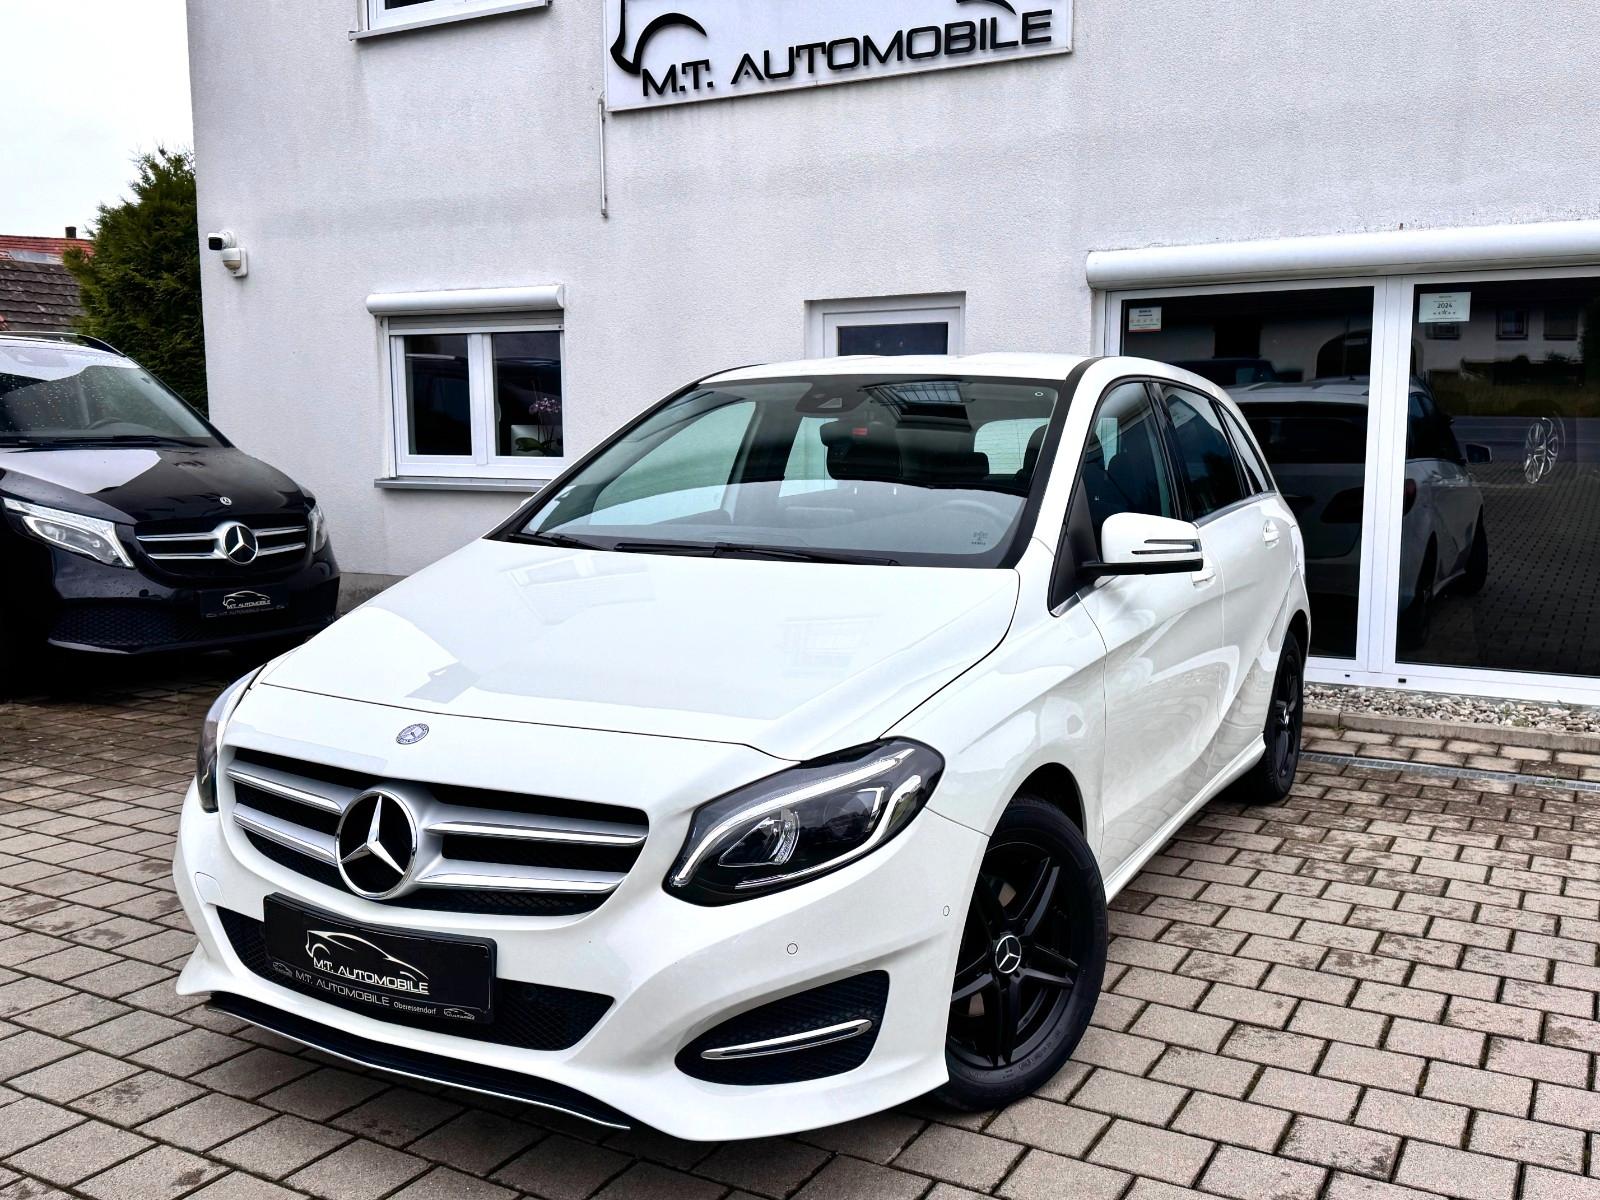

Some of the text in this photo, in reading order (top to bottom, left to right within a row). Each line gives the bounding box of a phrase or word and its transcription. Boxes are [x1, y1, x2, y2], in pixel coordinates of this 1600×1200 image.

[642, 9, 1053, 96] M.T. AUTOMOBILE
[316, 975, 390, 1006] AUTOMOBILE
[393, 1000, 437, 1016] Oberessendorf
[337, 965, 430, 995] AUTOMOBILE
